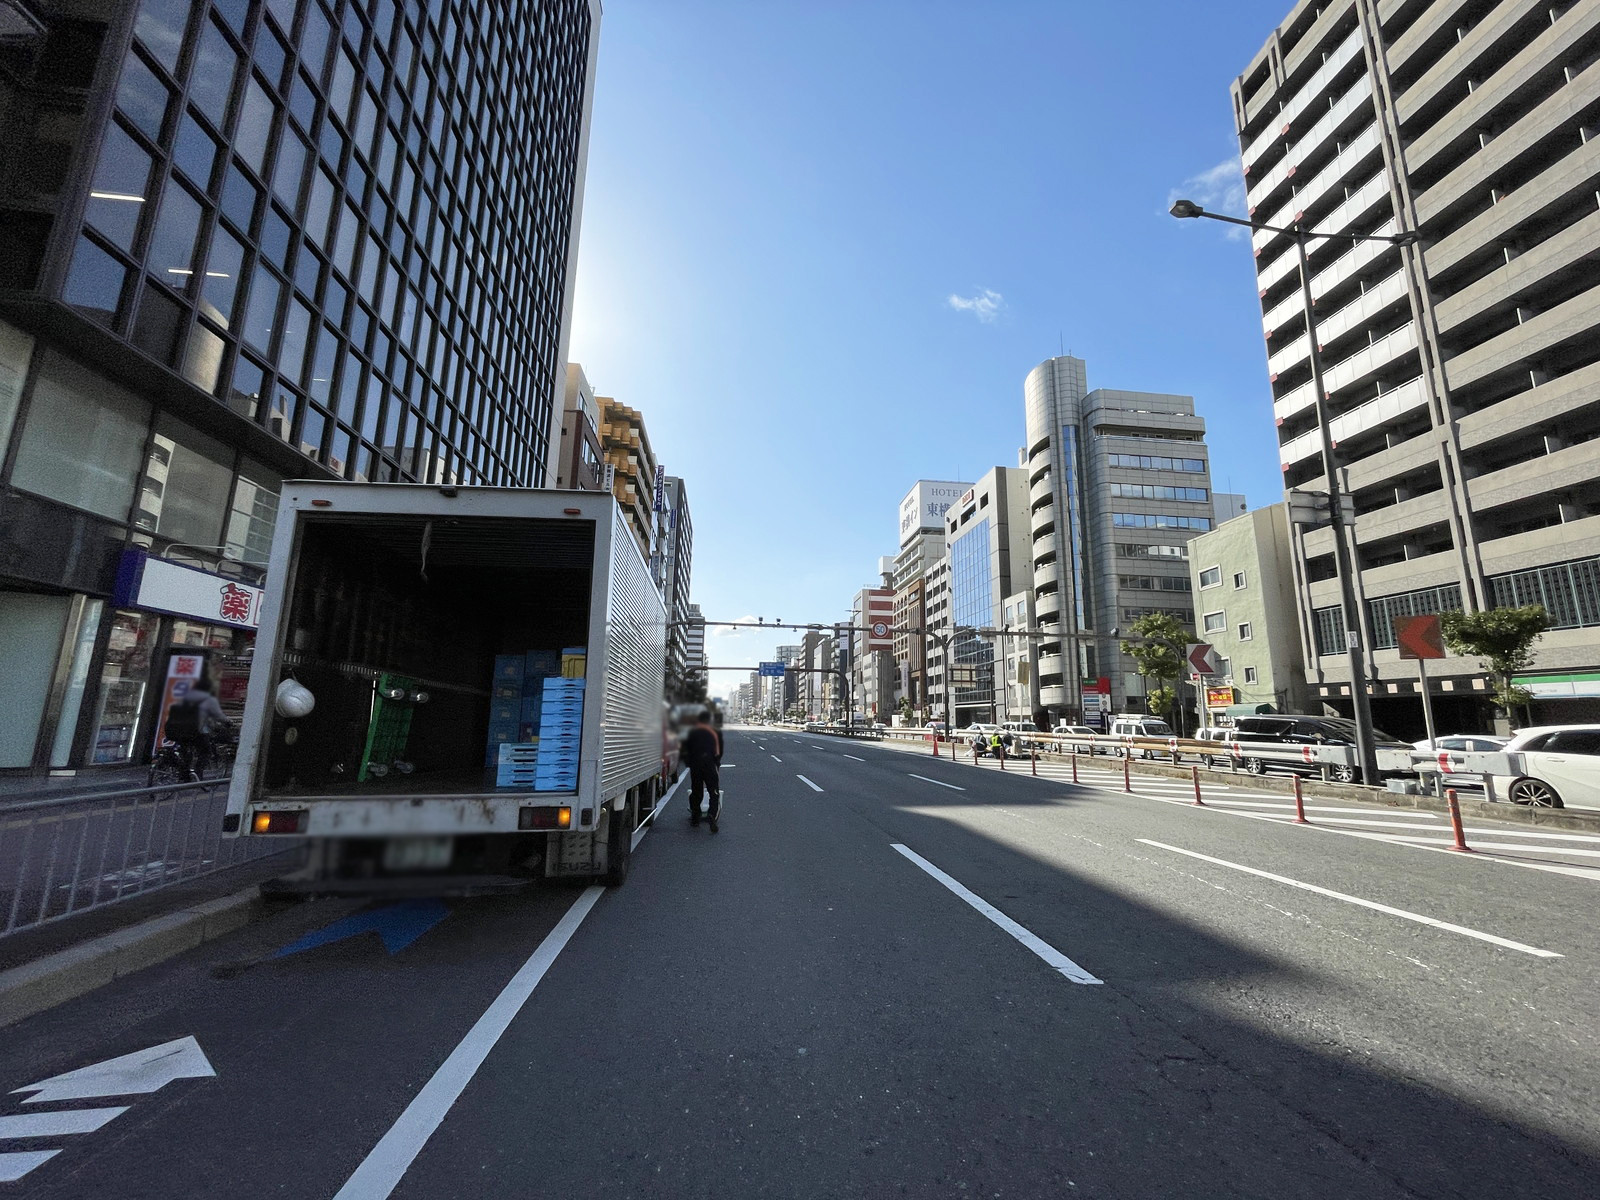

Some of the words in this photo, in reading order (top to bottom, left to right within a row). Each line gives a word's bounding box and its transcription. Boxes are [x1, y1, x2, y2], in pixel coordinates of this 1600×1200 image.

[931, 488, 963, 498] HOTEL
[220, 583, 253, 623] 薬
[876, 624, 885, 634] 50
